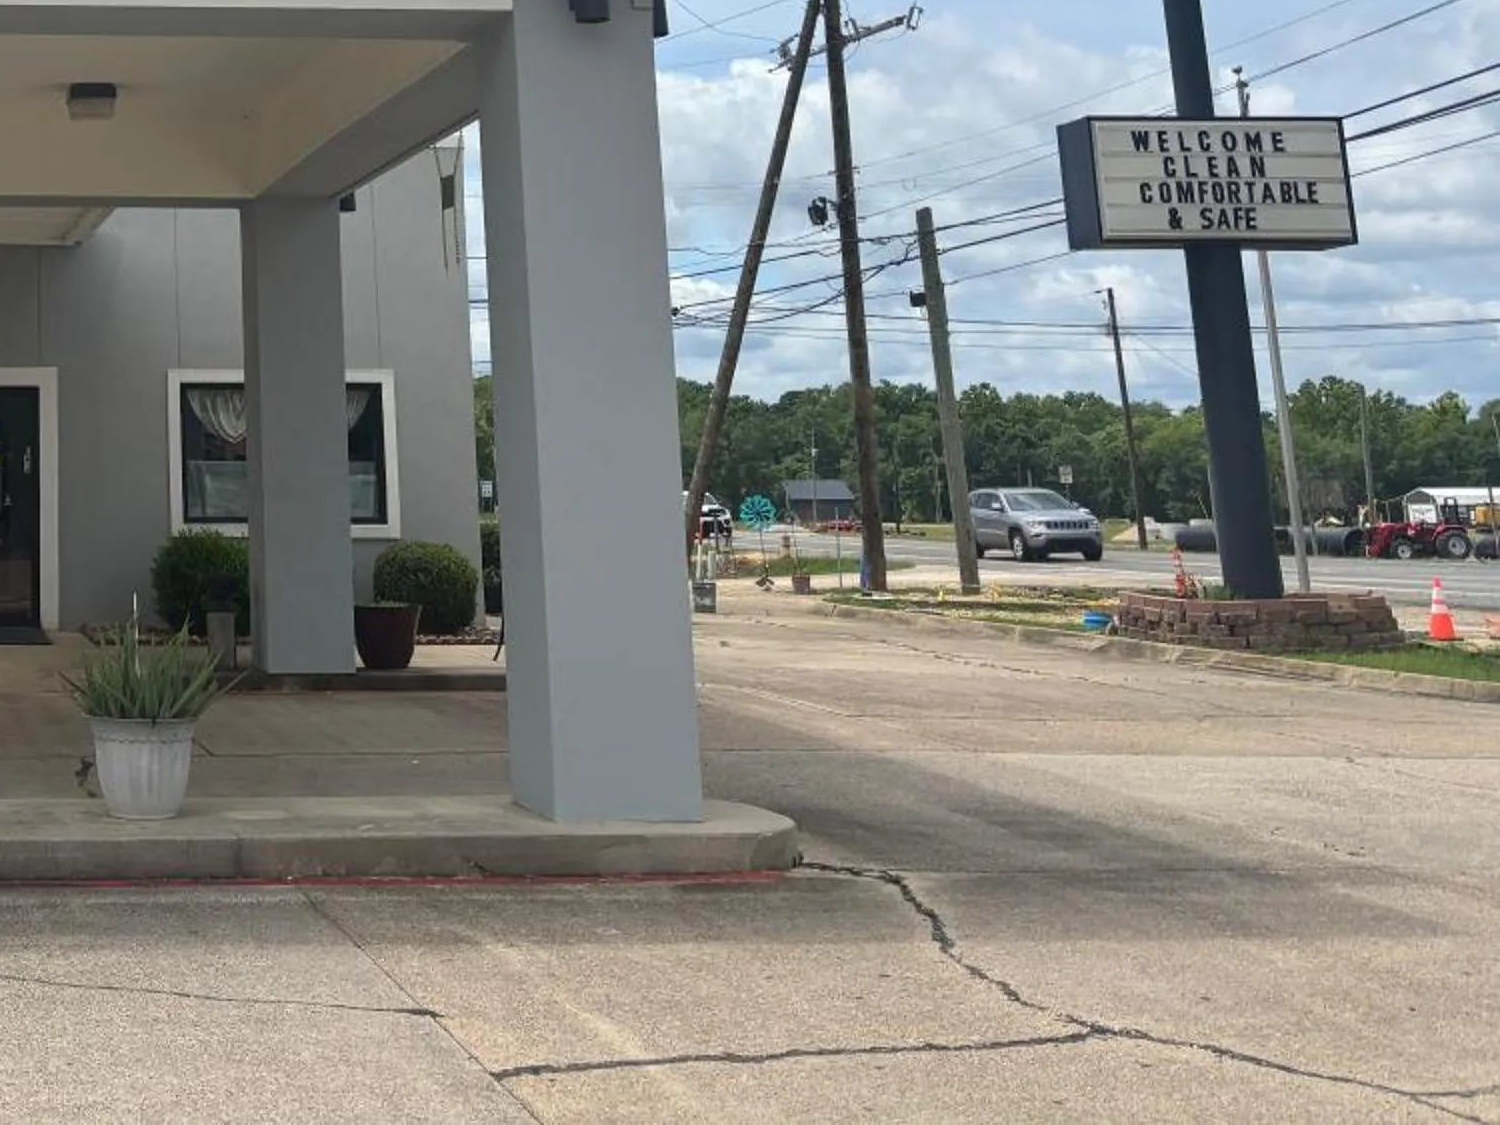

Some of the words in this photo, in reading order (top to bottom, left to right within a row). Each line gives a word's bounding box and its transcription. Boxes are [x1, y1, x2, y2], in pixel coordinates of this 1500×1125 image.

[1131, 130, 1286, 152] WELCOME
[1163, 156, 1266, 178] CLEAN
[1139, 181, 1319, 204] COMFORTABLE
[1168, 207, 1183, 229] &
[1200, 207, 1257, 230] SAFE
